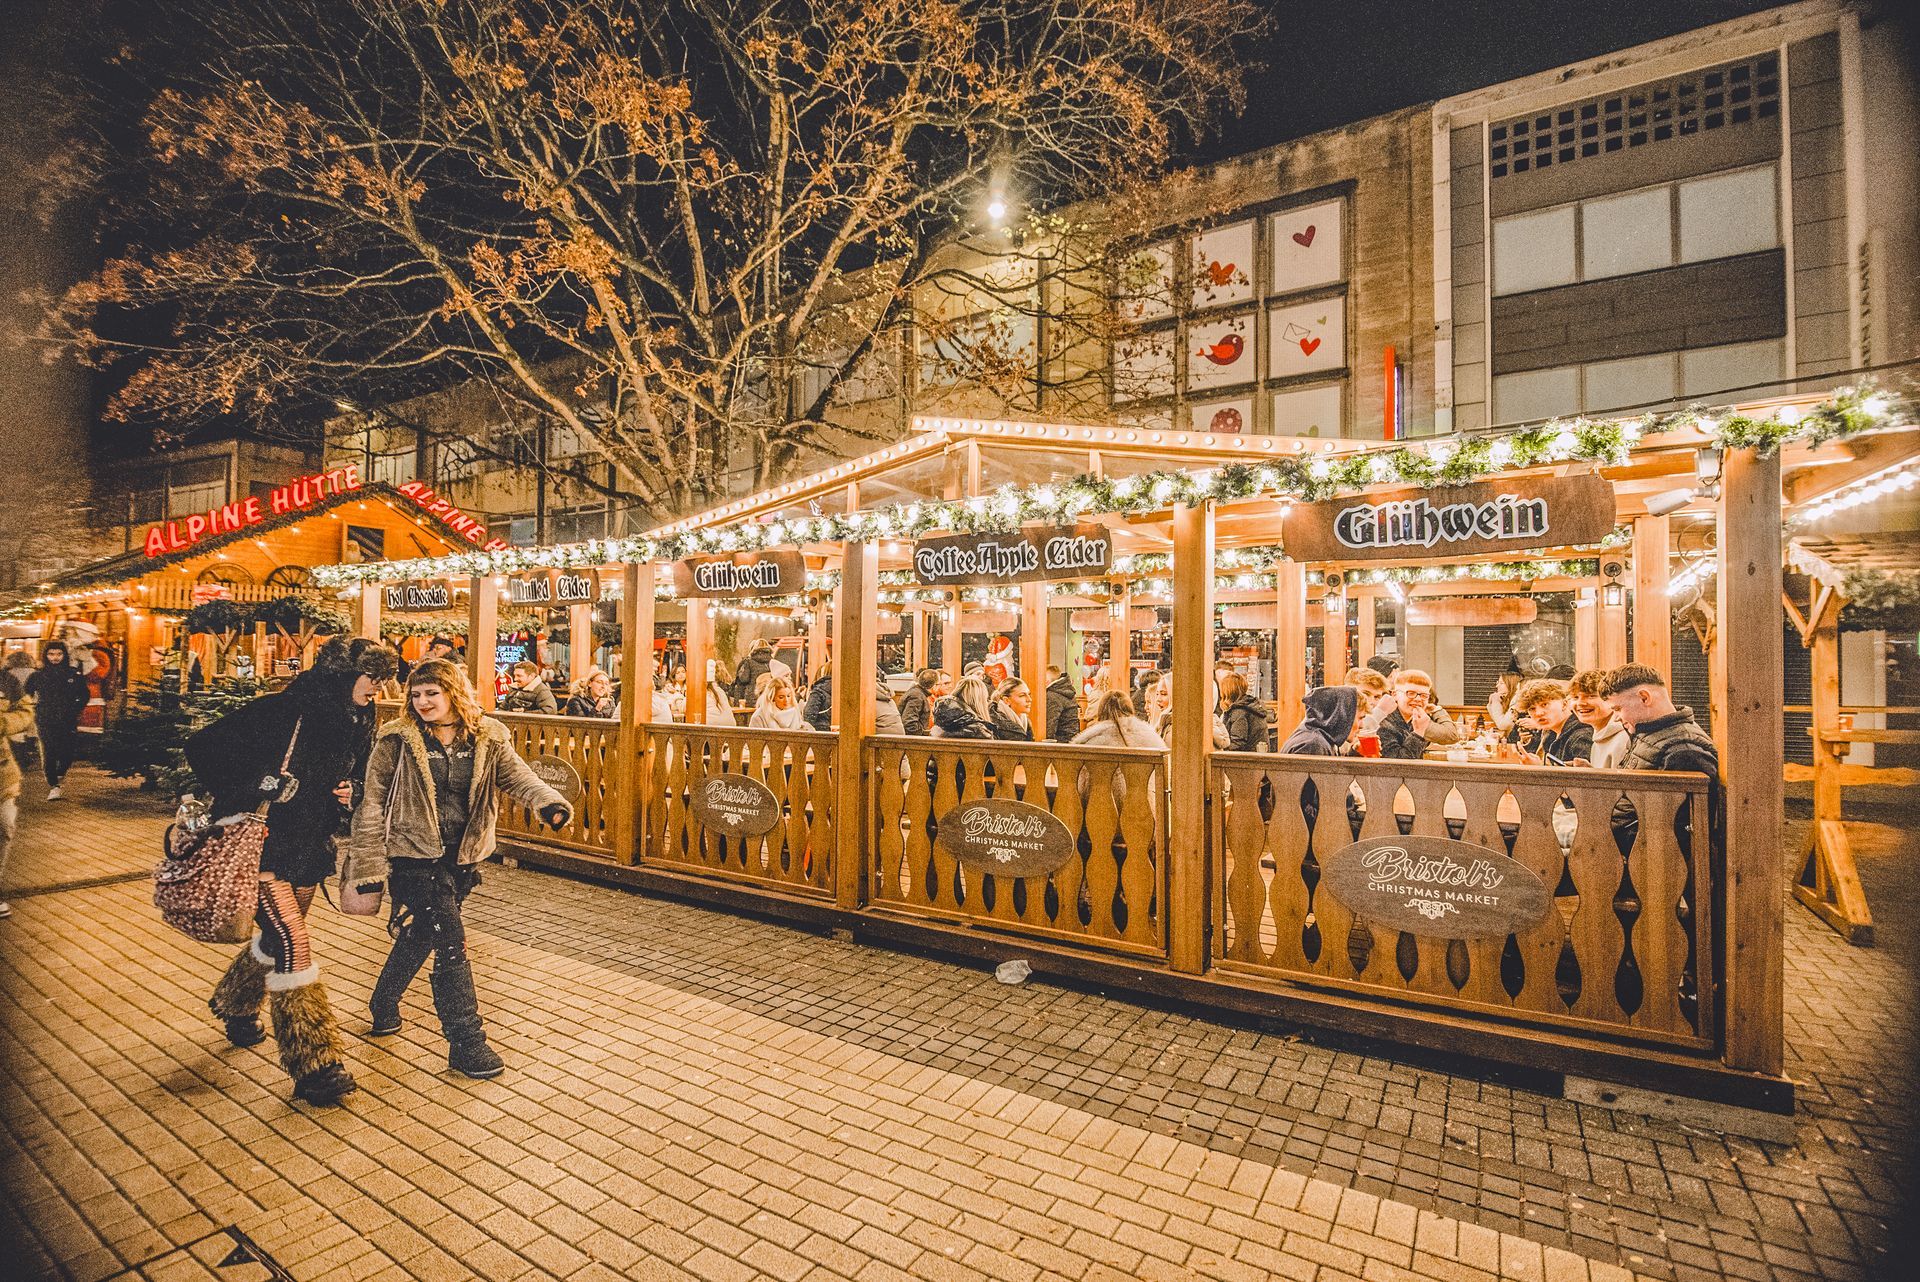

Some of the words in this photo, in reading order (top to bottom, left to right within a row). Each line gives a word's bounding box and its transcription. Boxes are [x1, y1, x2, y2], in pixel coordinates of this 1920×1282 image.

[144, 496, 263, 557] ALPINE
[271, 464, 361, 515] HÜTTE
[399, 481, 487, 544] ALPINE
[1334, 494, 1550, 548] Glühwein
[915, 545, 977, 581] Toffee
[977, 540, 1038, 577] Apple
[1045, 535, 1107, 570] Cider
[510, 577, 550, 603] Mulled
[556, 574, 592, 601] Cider
[694, 559, 780, 592] Glühwein
[387, 586, 403, 610] Hot
[407, 585, 449, 609] Chocolate
[706, 780, 762, 805] Bristol's
[707, 803, 737, 813] CHRISTMAS
[737, 807, 760, 816] MARKET
[961, 807, 1047, 838] Bristol's
[965, 835, 1009, 847] CHRISTMAS
[1011, 841, 1044, 851] MARKET
[1361, 846, 1504, 889] Bristol's
[1368, 882, 1440, 899] CHRISTMAS
[1445, 891, 1500, 906] MARKET
